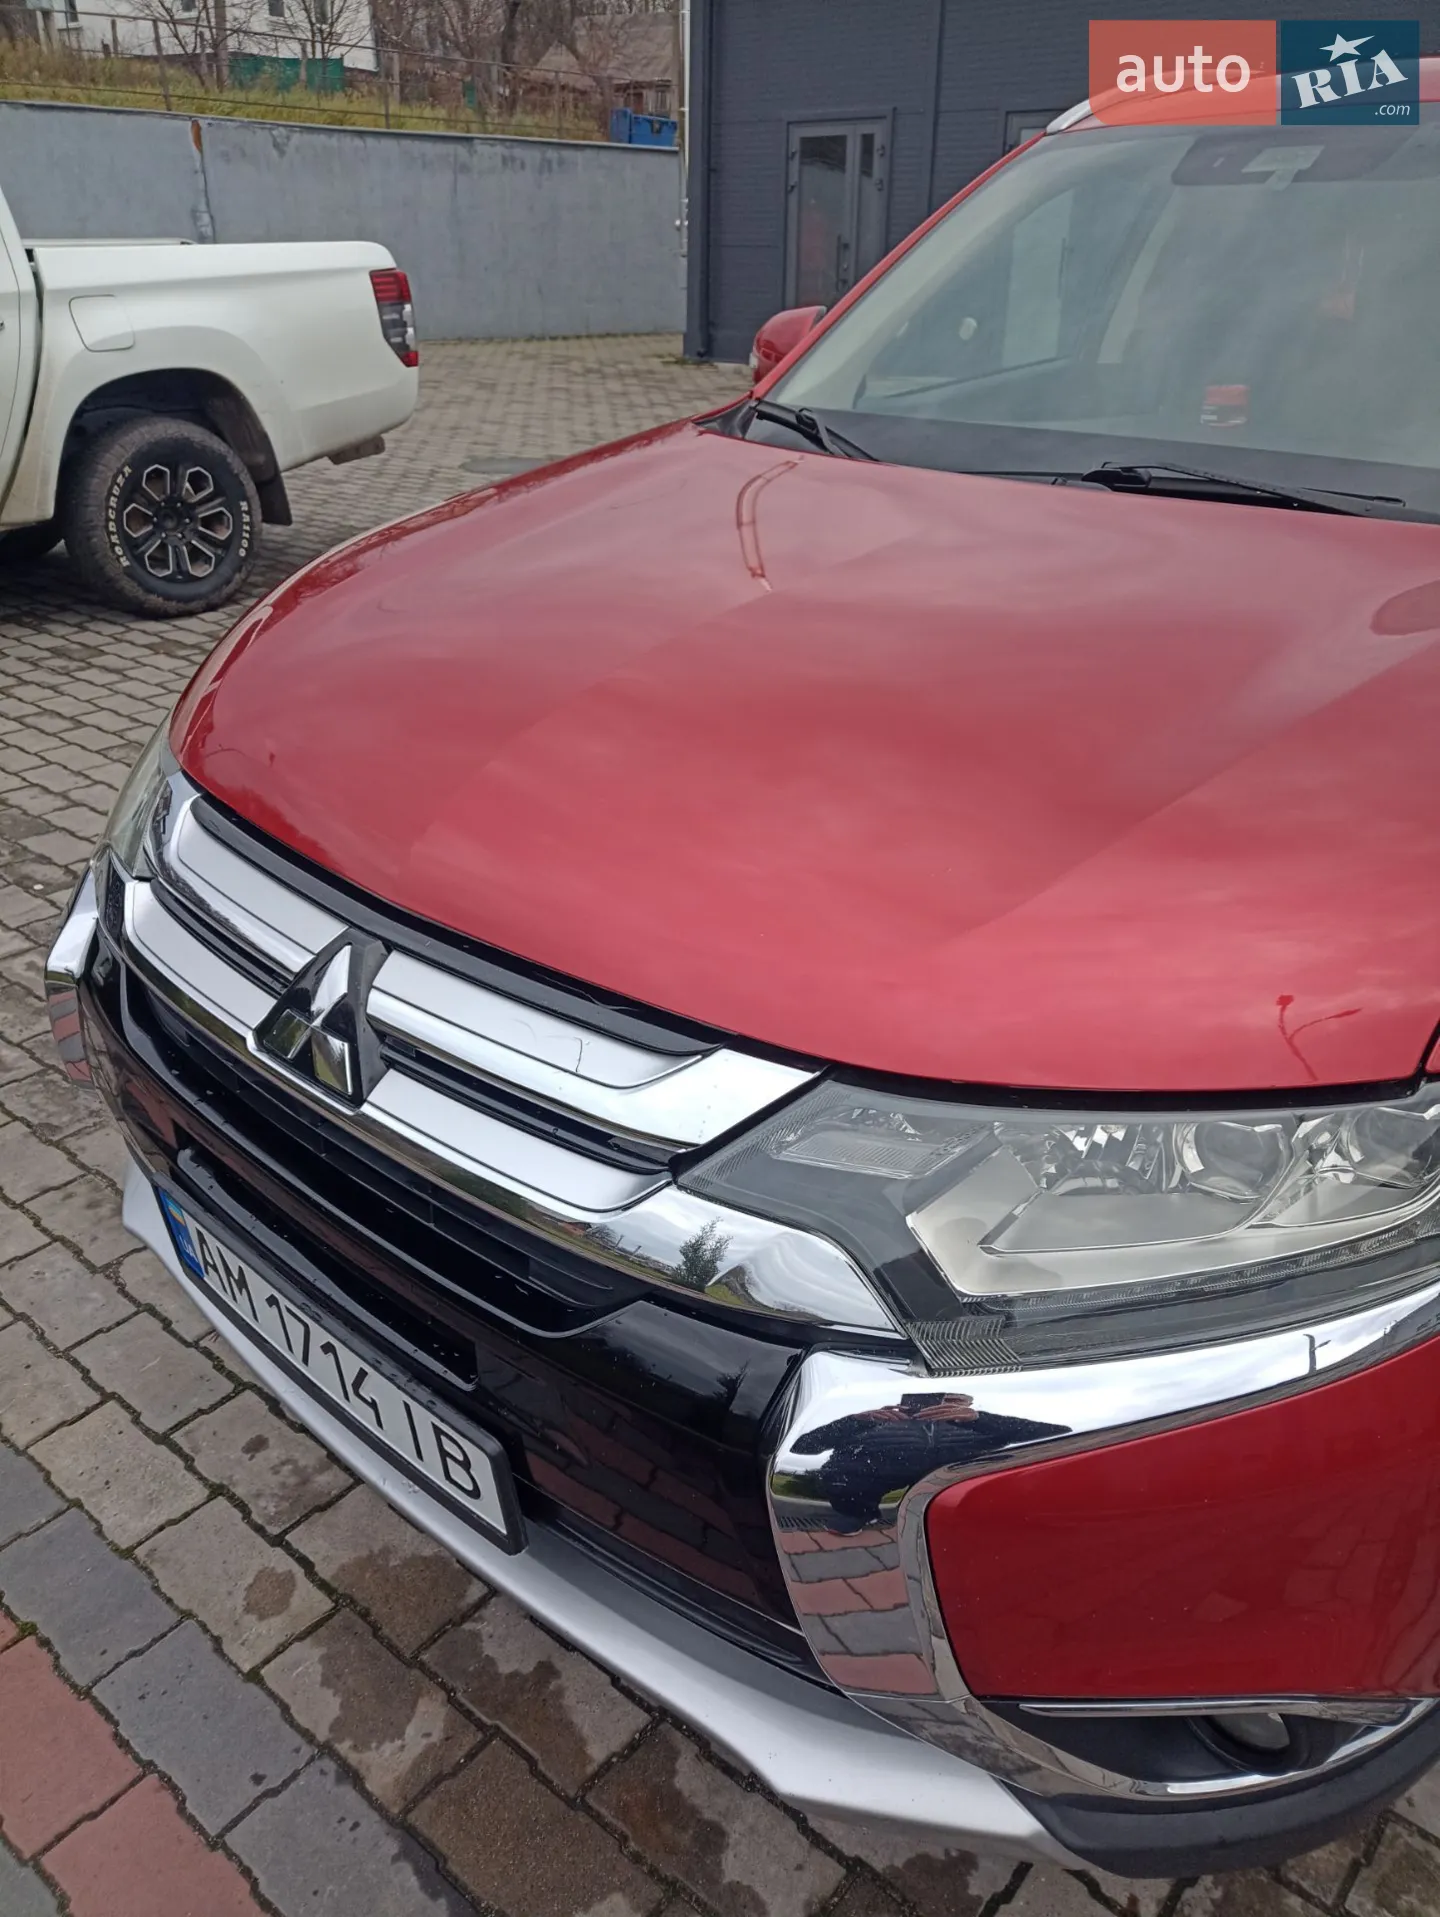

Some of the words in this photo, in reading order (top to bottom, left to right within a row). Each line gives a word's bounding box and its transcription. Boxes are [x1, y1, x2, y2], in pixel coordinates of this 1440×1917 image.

[108, 465, 132, 567] ROADCRUZA
[195, 1226, 260, 1323] AM
[265, 1293, 384, 1431] 1714
[402, 1399, 482, 1501] IB
